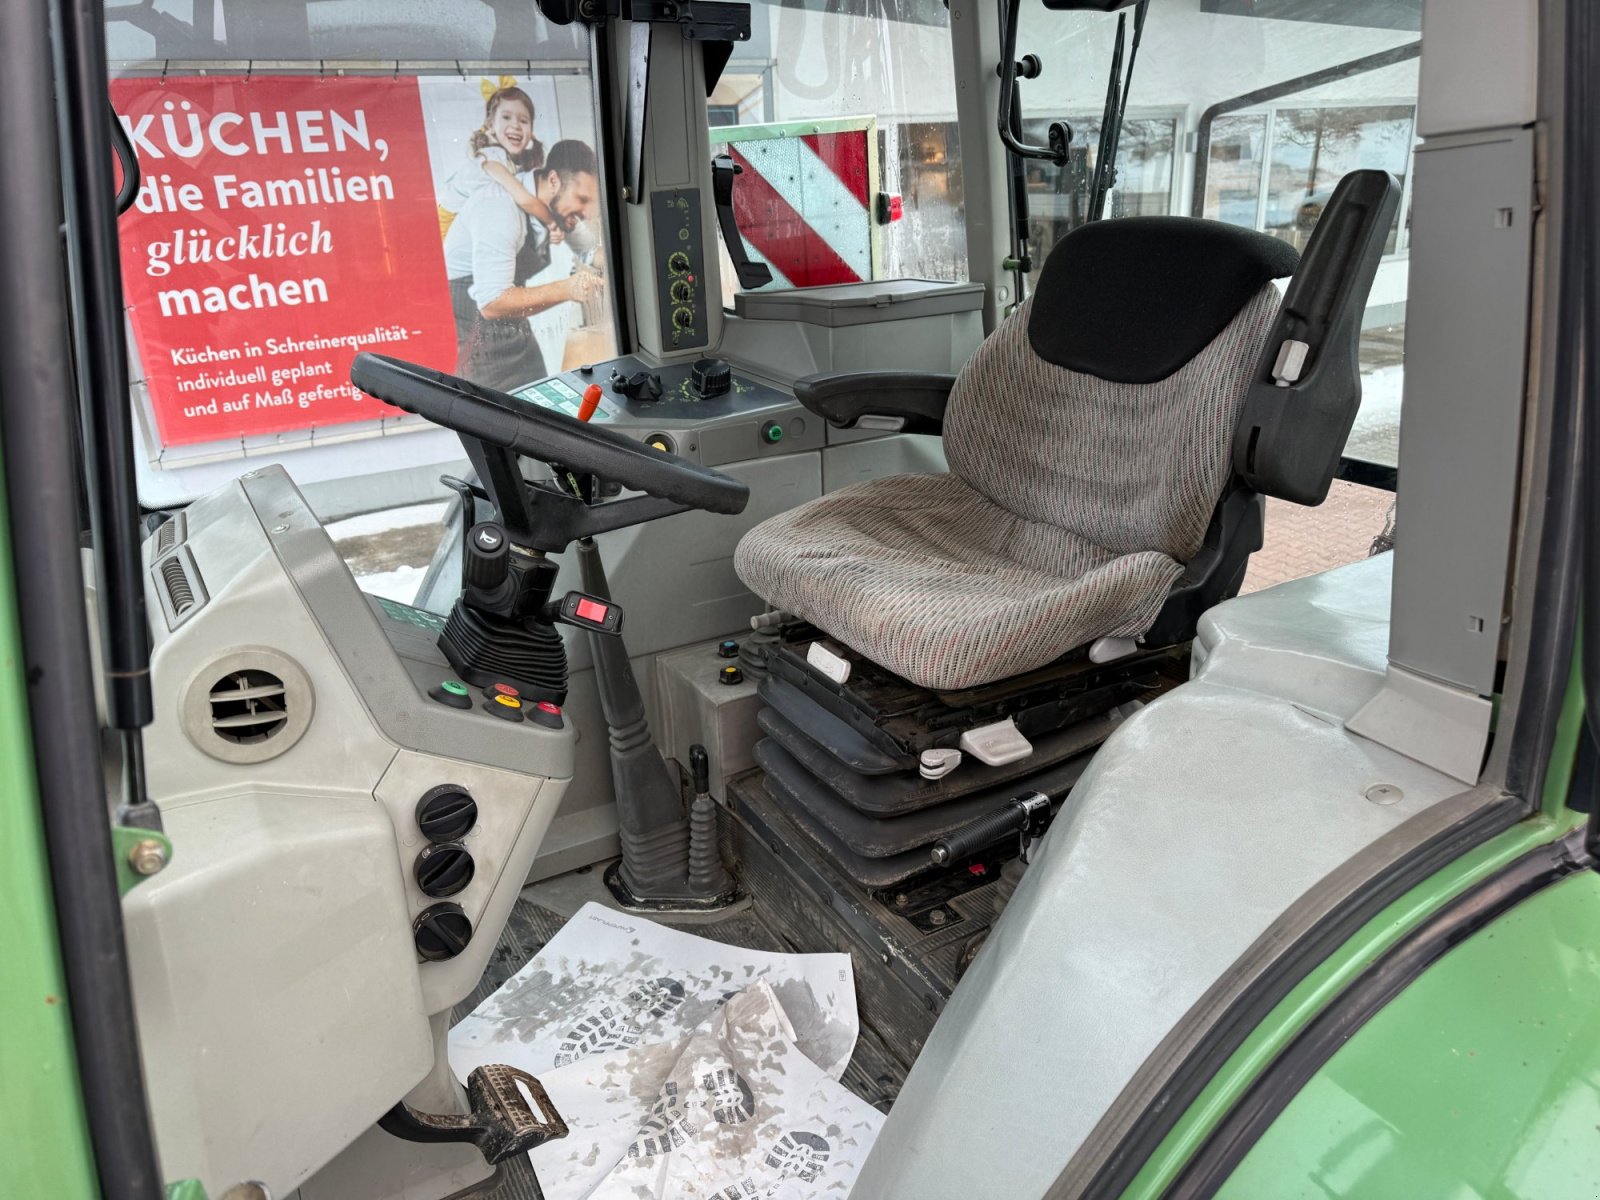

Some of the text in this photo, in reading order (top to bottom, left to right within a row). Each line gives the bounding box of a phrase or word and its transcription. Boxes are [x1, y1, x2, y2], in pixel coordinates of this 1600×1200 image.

[120, 101, 388, 161] KÜCHEN,
[135, 167, 394, 213] die Familien
[147, 220, 333, 276] glücklich
[158, 274, 328, 316] machen
[171, 346, 241, 366] Küchen
[244, 342, 262, 357] in
[266, 326, 408, 355] Schreinerqualität
[177, 362, 332, 391] individuell geplant
[184, 382, 366, 417] und auf Maß gefertig
